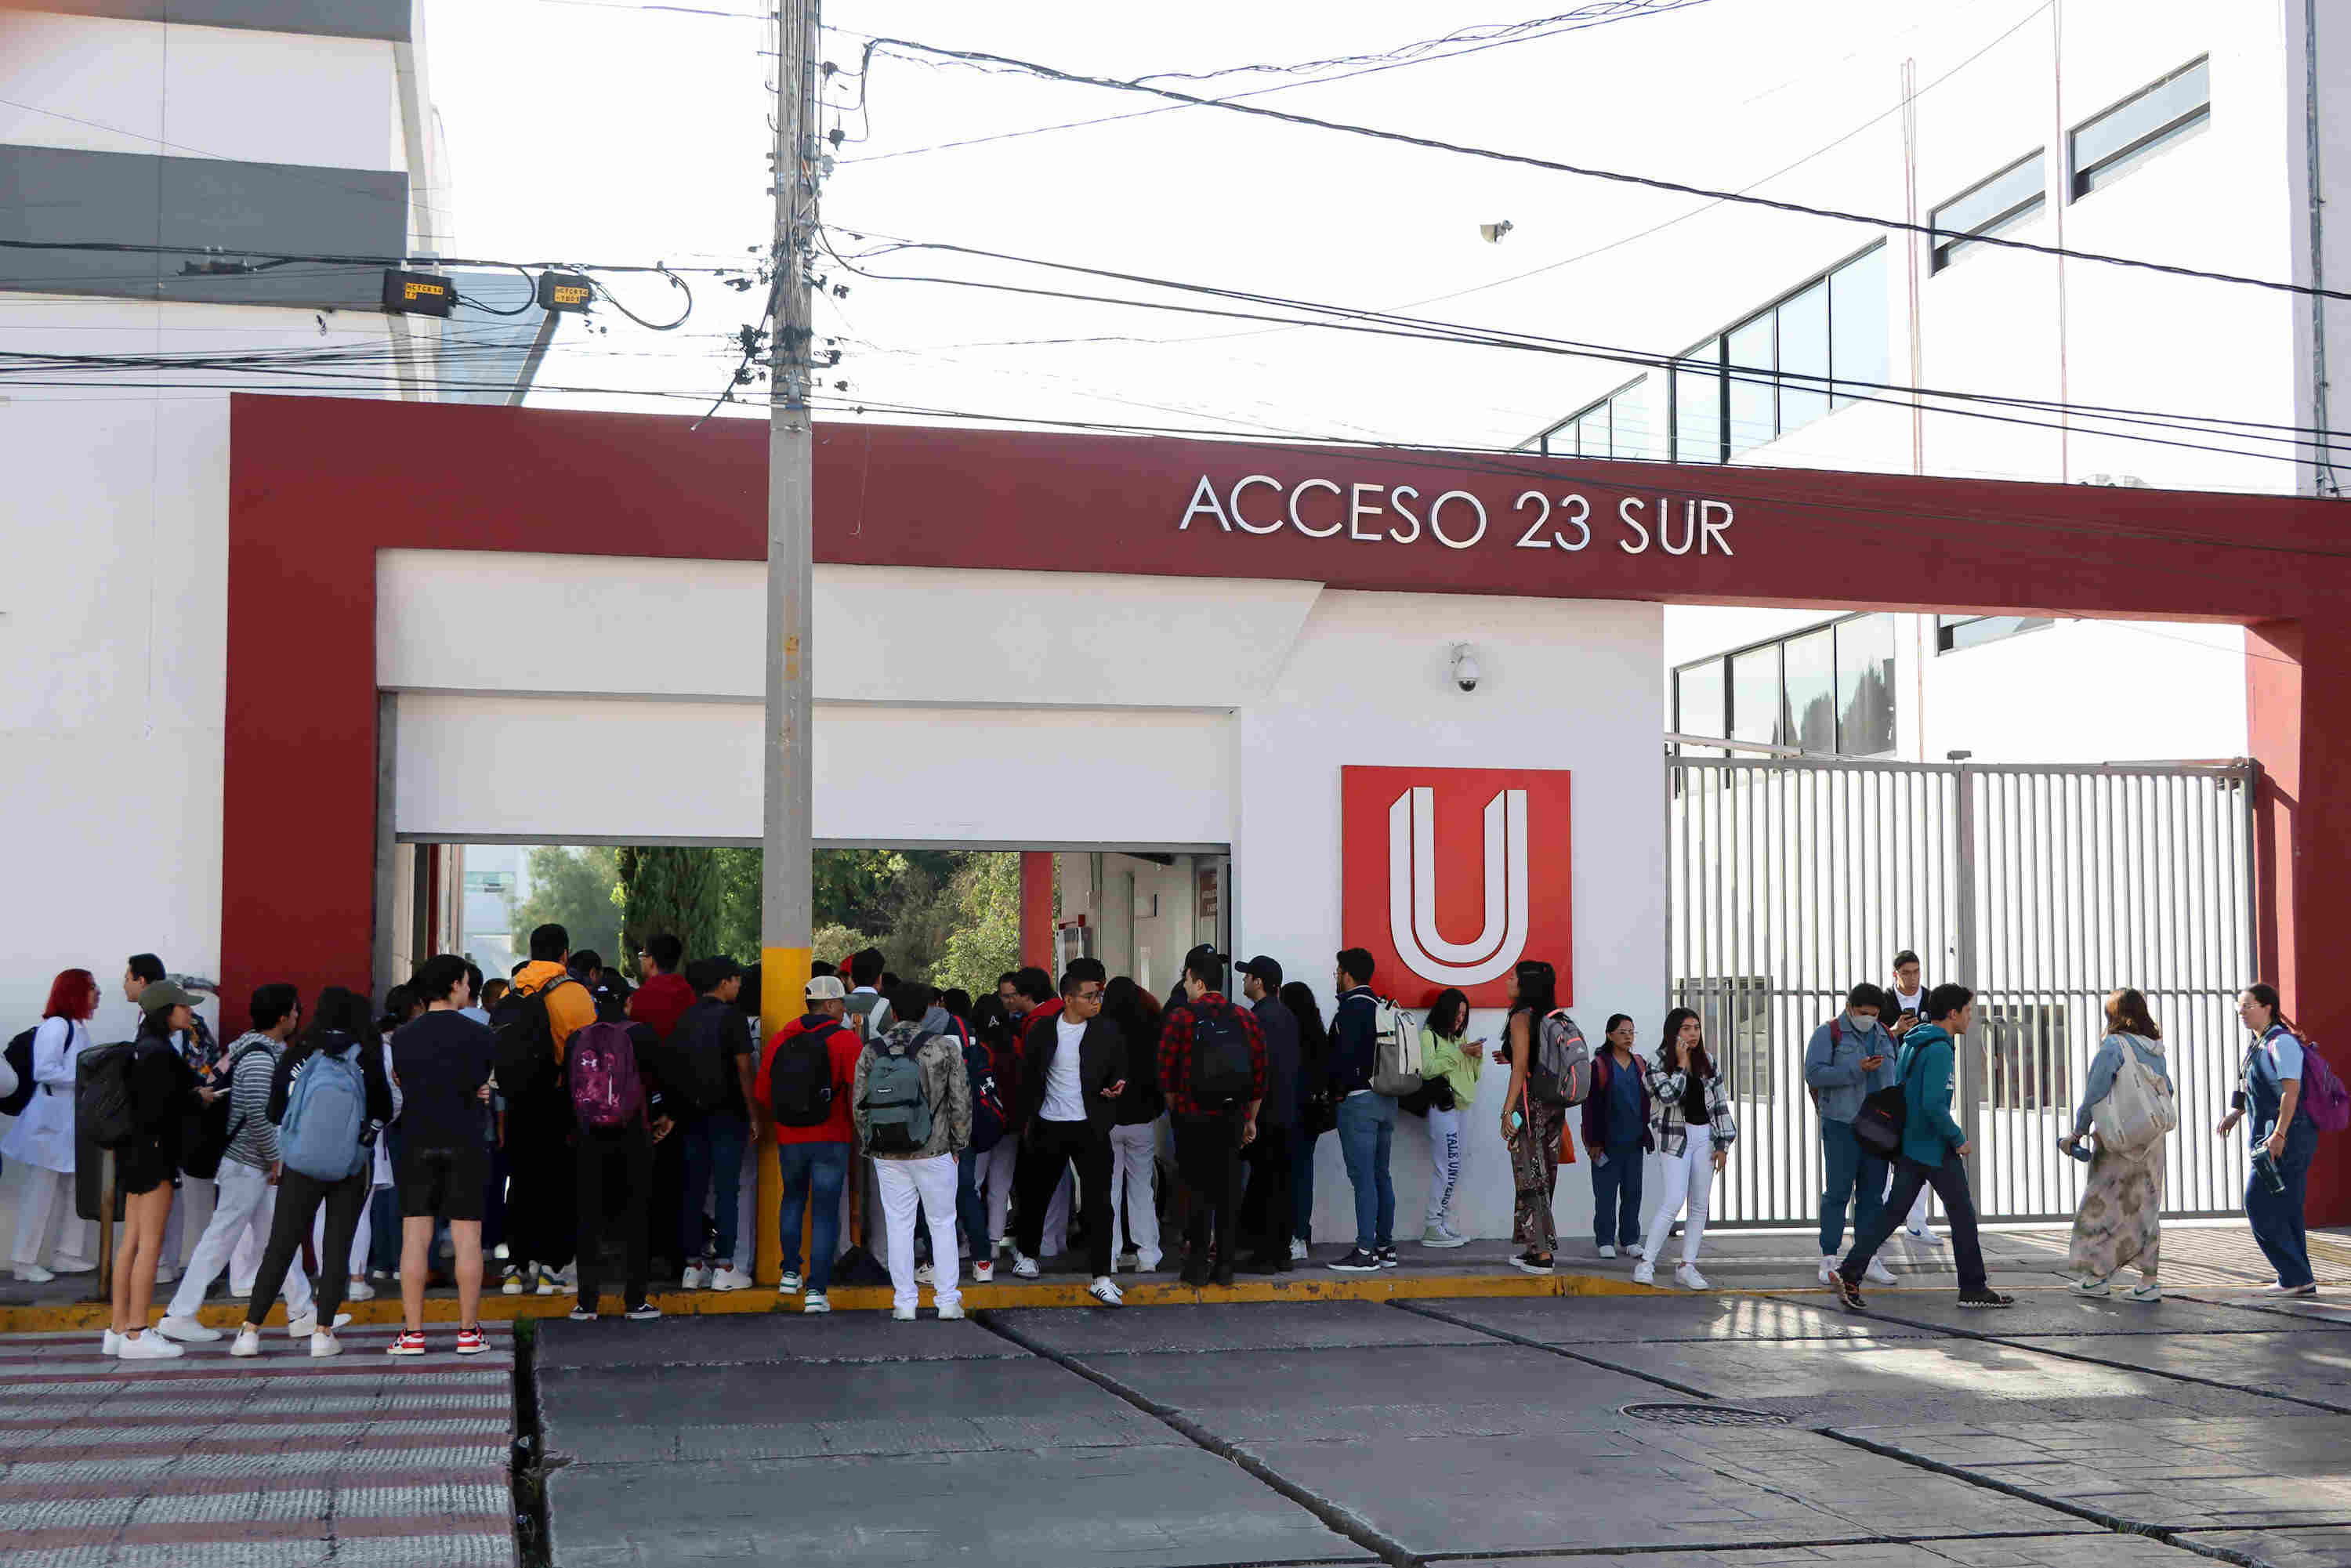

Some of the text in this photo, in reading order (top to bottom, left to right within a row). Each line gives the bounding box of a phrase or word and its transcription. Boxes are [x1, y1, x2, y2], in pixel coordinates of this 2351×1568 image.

[1179, 473, 1735, 556] ACCESO 23 SUR
[1447, 1132, 1458, 1160] YALE
